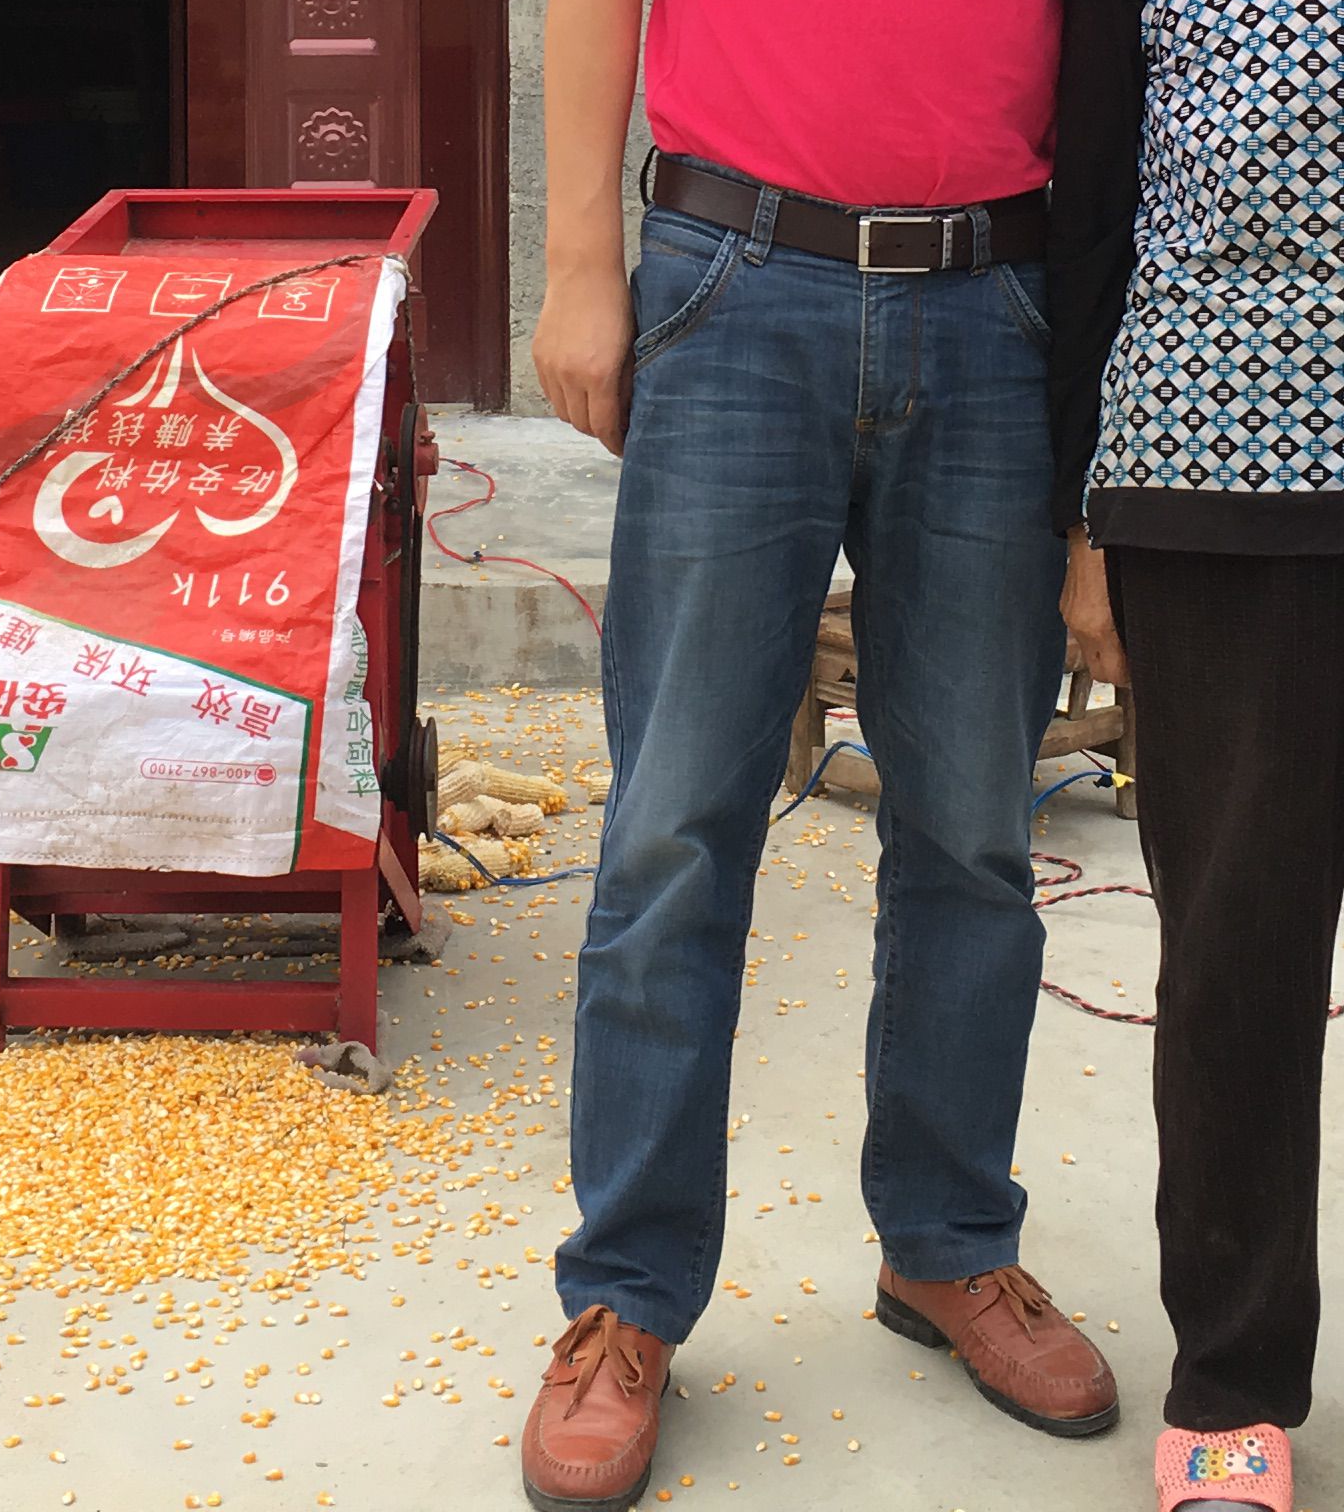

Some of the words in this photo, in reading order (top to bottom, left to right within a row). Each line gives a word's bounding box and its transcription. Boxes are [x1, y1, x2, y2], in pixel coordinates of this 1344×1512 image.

[94, 455, 275, 496] 吃安佑料
[71, 642, 157, 697] 环保
[190, 677, 283, 741] 高效
[147, 761, 253, 779] 400-867-2100
